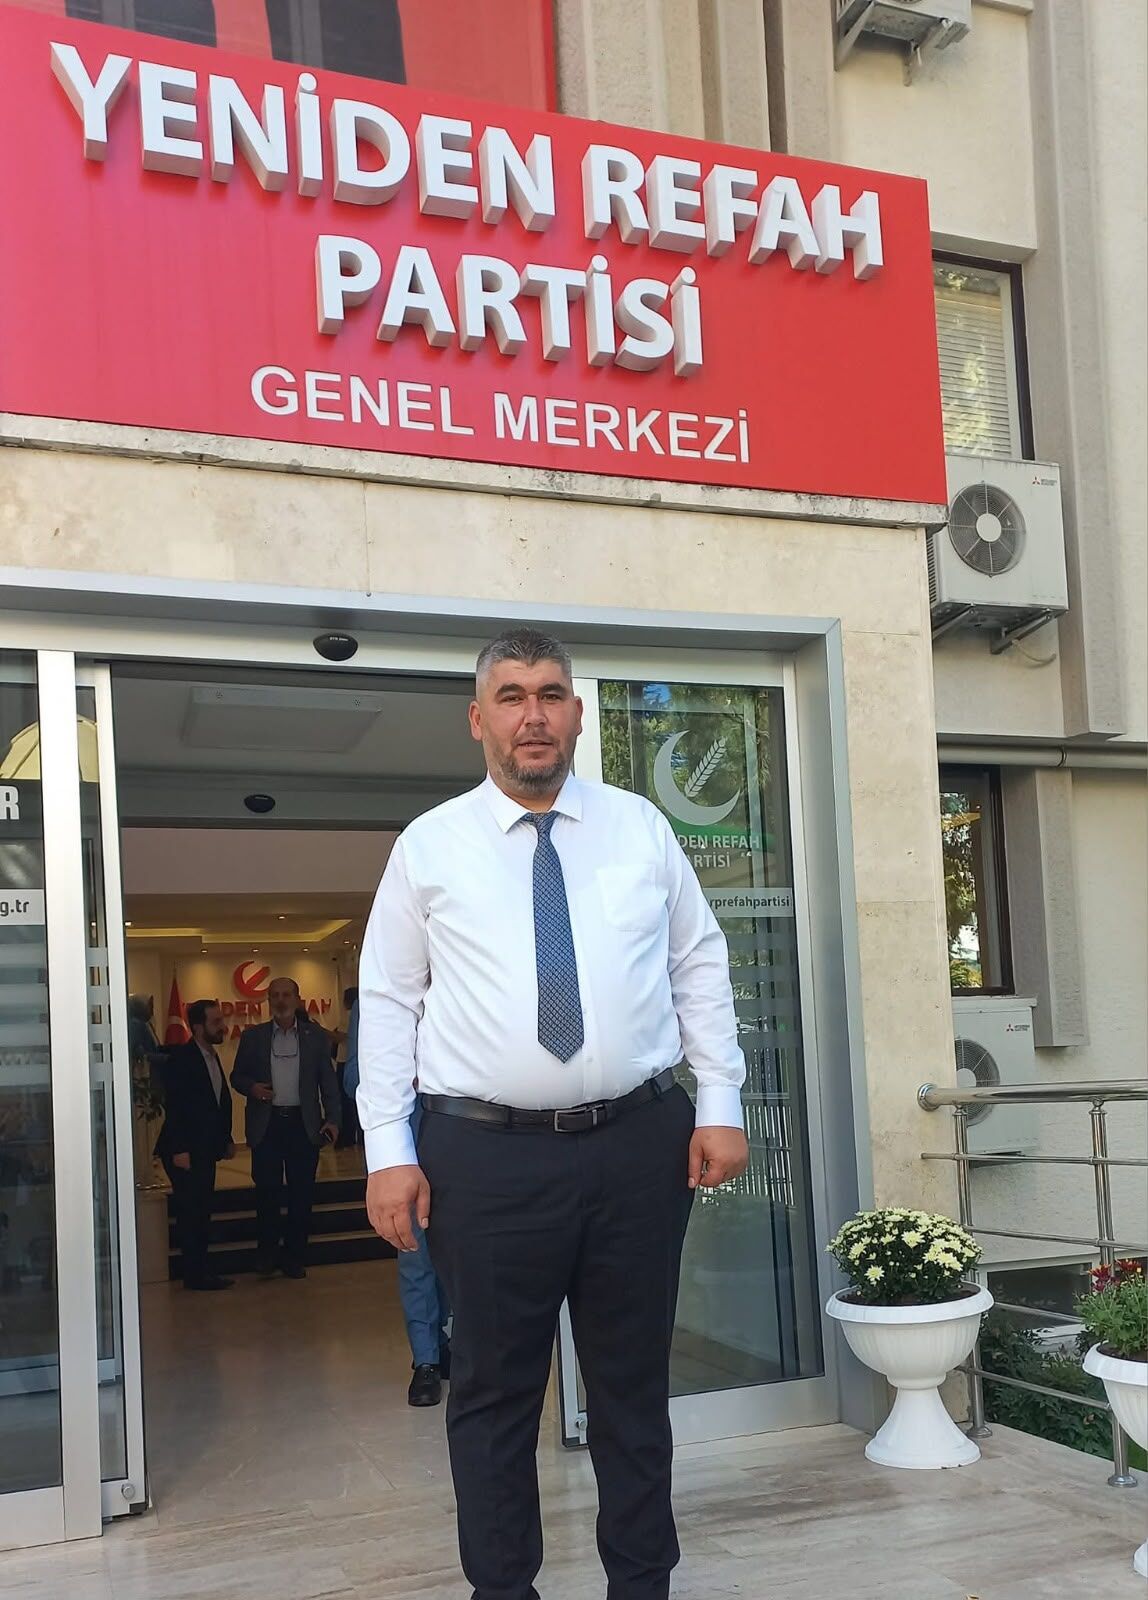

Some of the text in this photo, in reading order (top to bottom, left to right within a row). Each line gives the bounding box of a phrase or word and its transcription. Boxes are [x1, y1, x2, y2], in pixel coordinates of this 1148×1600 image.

[50, 41, 884, 281] YENİDEN REFAH
[315, 234, 704, 377] PARTİSİ
[250, 364, 750, 464] GENEL MERKEZİ
[677, 834, 760, 848] DEN REFAH
[688, 851, 731, 868] RTİSİ
